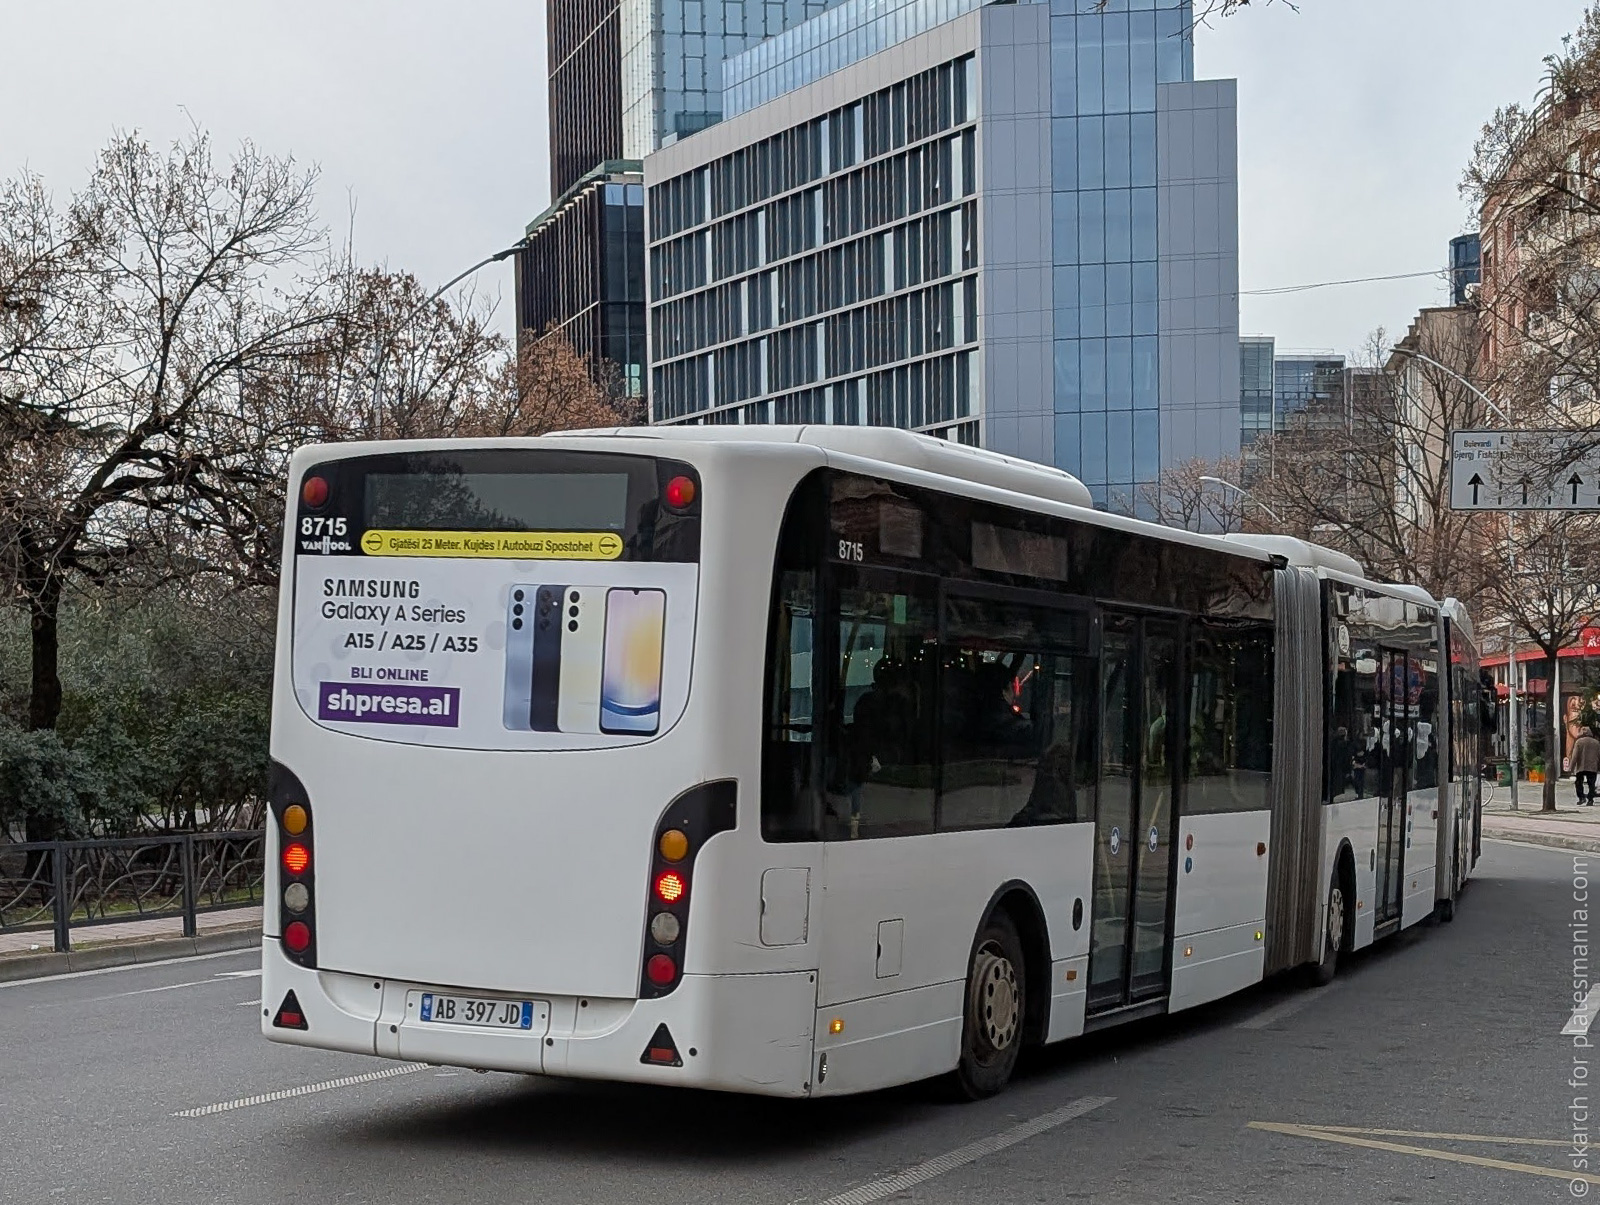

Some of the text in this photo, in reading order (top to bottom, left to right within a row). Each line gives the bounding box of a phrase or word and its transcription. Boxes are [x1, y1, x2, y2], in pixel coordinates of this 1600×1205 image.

[301, 517, 347, 536] 8715
[389, 538, 420, 552] Gjatësi
[422, 539, 433, 550] 25
[463, 539, 495, 553] Kujdes
[497, 540, 501, 550] !
[502, 540, 544, 551] Autobuzi
[545, 540, 594, 553] Spostohet
[838, 539, 864, 562] 8715
[323, 578, 420, 599] SAMSUNG
[321, 600, 466, 626] Galaxy A Series
[344, 630, 478, 653] A15 / A25 / A35
[351, 666, 429, 681] BLI ONLINE
[327, 688, 451, 717] shpresa.al
[435, 998, 520, 1025] AB 397 JD
